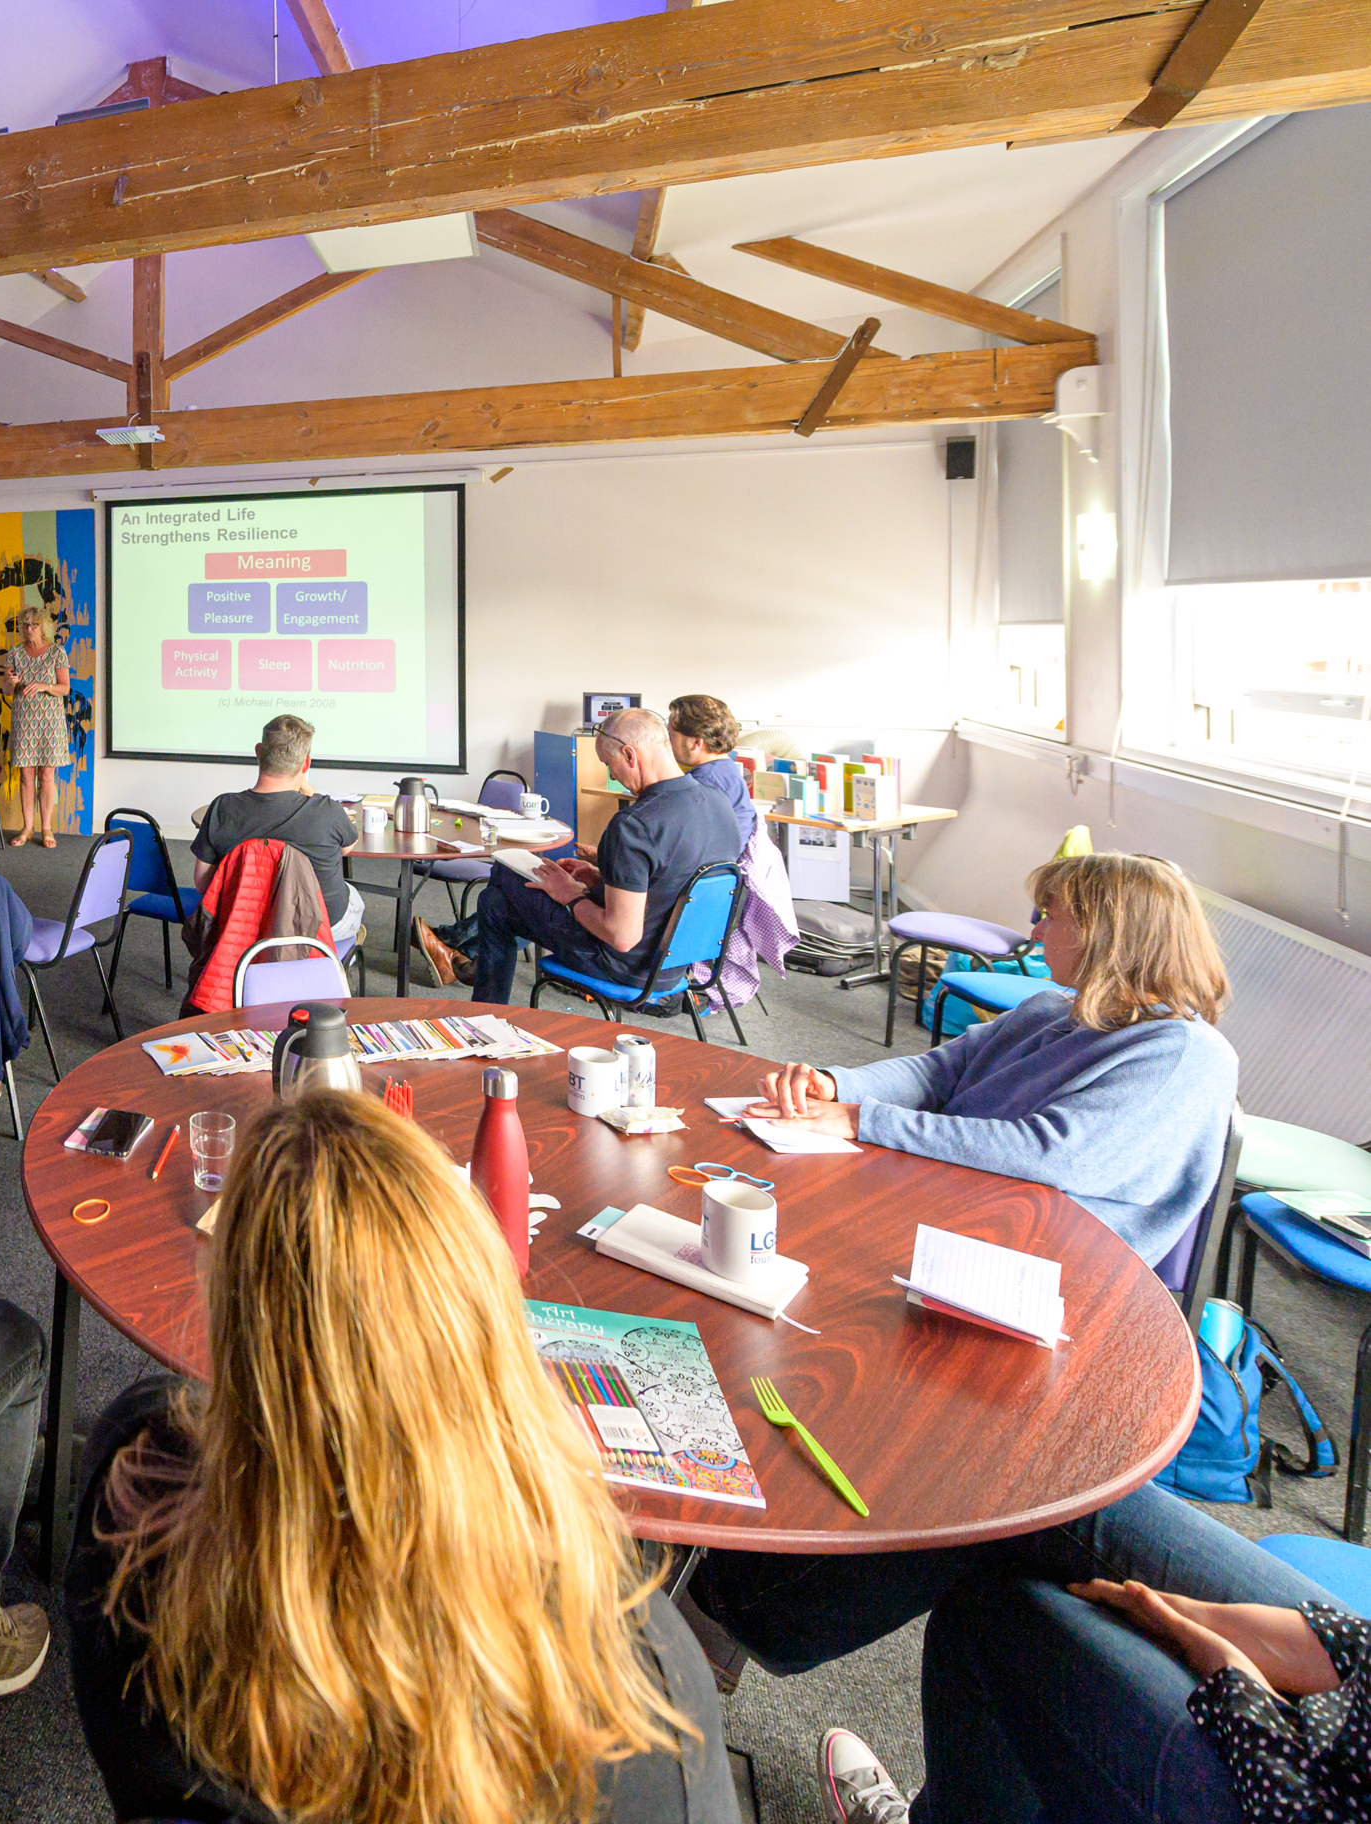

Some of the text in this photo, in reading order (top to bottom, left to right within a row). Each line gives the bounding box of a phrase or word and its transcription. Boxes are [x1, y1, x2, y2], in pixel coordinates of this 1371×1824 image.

[121, 508, 255, 526] An Integrated Life
[121, 527, 297, 546] Strengthens Resilience
[237, 554, 311, 571] Meaning
[206, 591, 251, 602] Positive
[295, 589, 347, 603] Growth/
[204, 612, 253, 623] Pleasure
[283, 613, 359, 627] Engagement
[174, 650, 218, 663] Physical
[258, 659, 291, 672] Sleep
[328, 660, 385, 671] Nutrition
[175, 667, 217, 679] Activity
[218, 697, 231, 708] (c)
[234, 697, 272, 707] Michael
[309, 698, 336, 709] 2008
[750, 1228, 777, 1251] LG
[541, 1306, 575, 1320] Art
